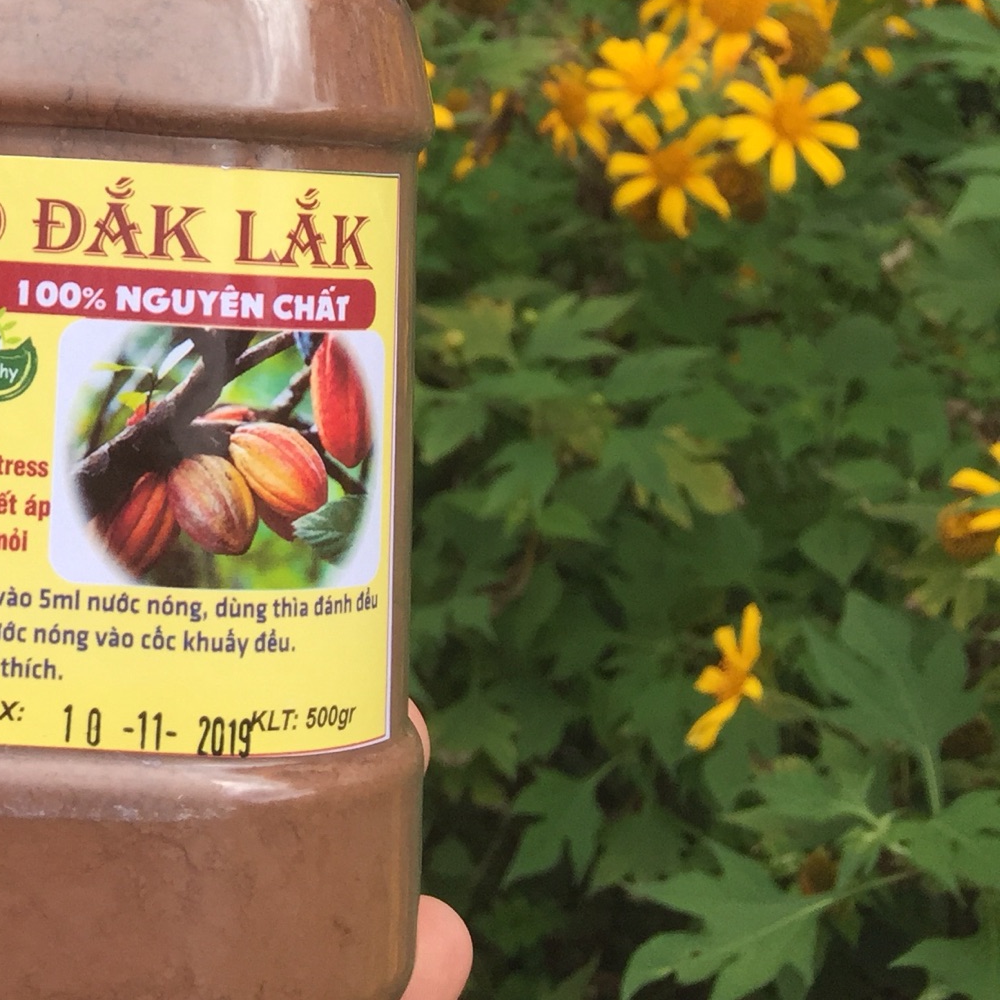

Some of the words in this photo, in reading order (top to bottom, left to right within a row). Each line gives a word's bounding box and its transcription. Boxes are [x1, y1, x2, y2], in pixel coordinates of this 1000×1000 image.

[33, 176, 211, 263] ĐẮK
[234, 188, 374, 271] LẮK
[17, 279, 106, 312] 100%
[116, 283, 264, 320] NGUYÊN
[273, 285, 350, 322] CHẤT
[24, 493, 51, 521] áp
[39, 588, 80, 610] 5ml
[87, 592, 140, 613] nước
[147, 595, 207, 622] nóng,
[215, 597, 267, 623] dùng
[273, 597, 308, 618] thìa
[314, 593, 352, 616] đánh
[34, 624, 89, 651] nóng
[95, 626, 134, 649] vào
[141, 625, 176, 651] cốc
[183, 628, 249, 659] khuấy
[254, 629, 295, 653] đều.
[0, 656, 63, 681] thích.
[250, 709, 298, 732] KLT:
[306, 705, 356, 731] 500gr
[196, 715, 253, 758] 2019
